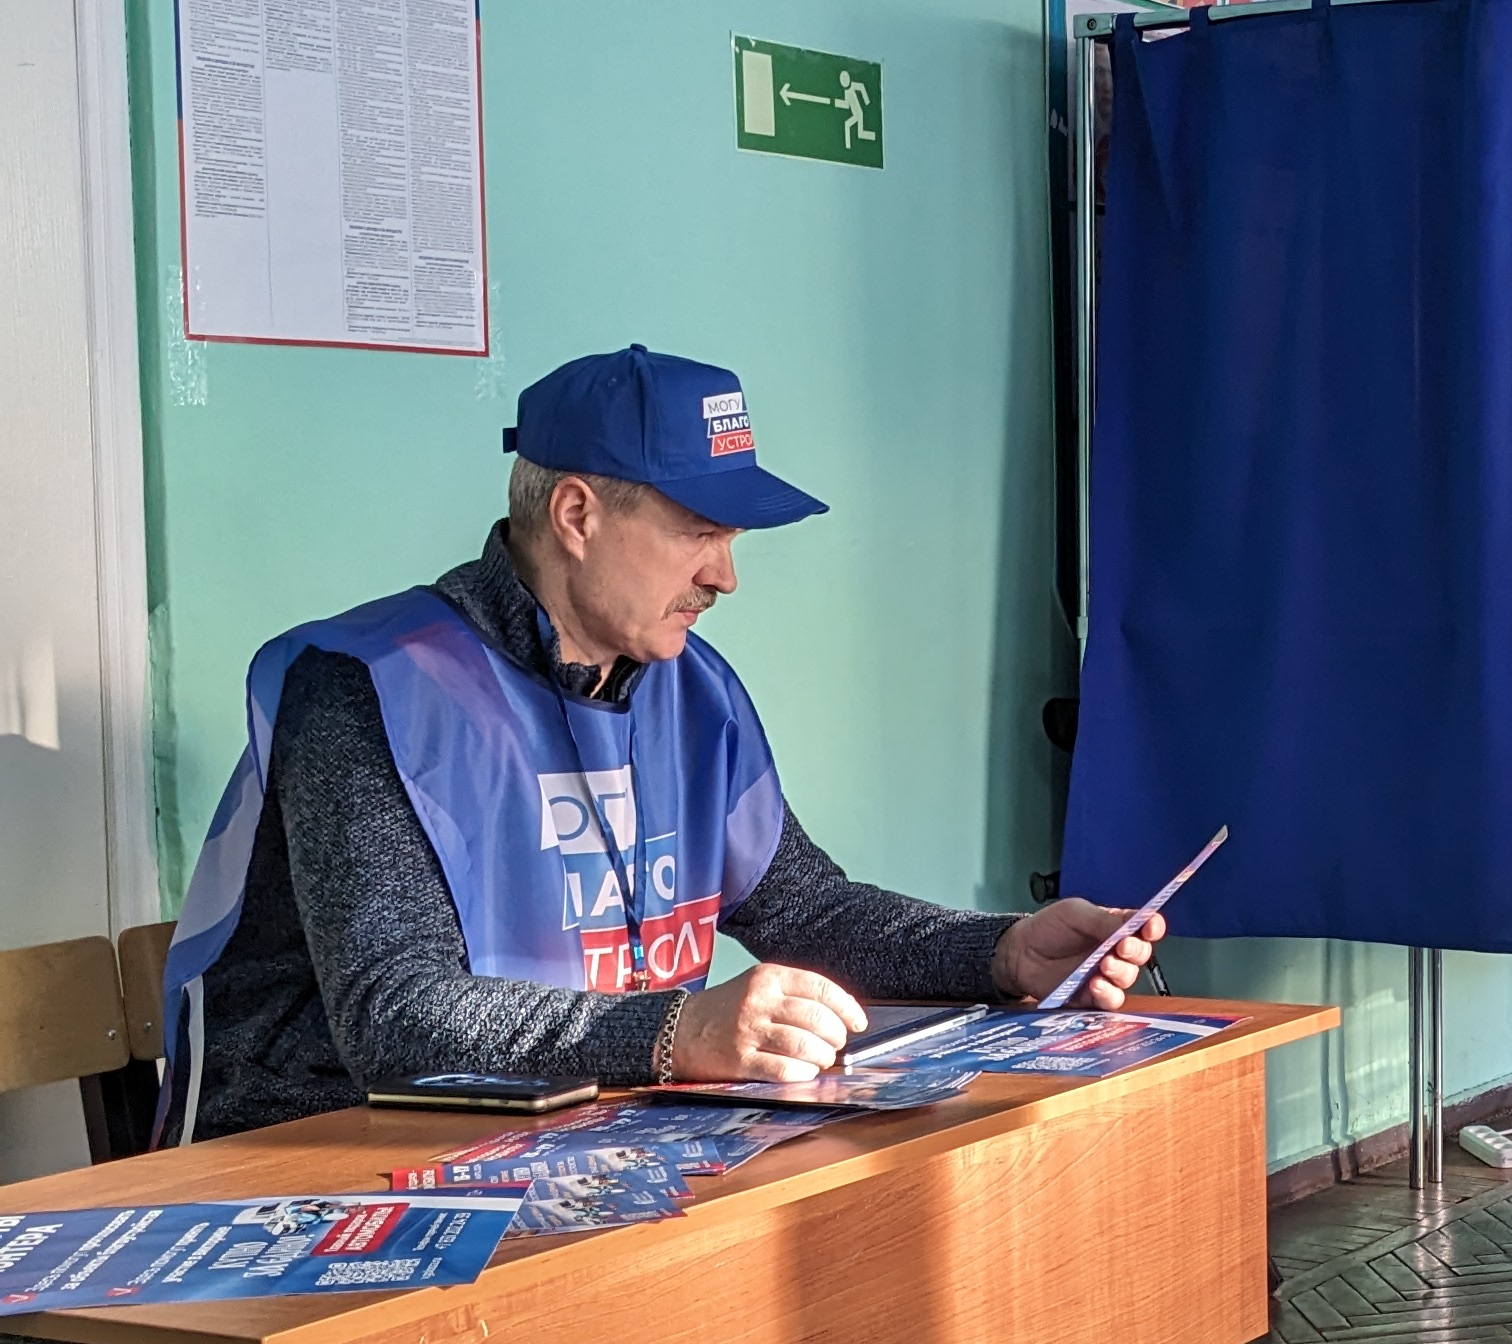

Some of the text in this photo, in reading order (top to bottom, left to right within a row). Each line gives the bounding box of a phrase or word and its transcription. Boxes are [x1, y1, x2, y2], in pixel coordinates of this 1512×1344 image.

[707, 399, 741, 414] МОГУ
[712, 415, 749, 433] БЛАГО
[716, 433, 753, 451] УСТРО
